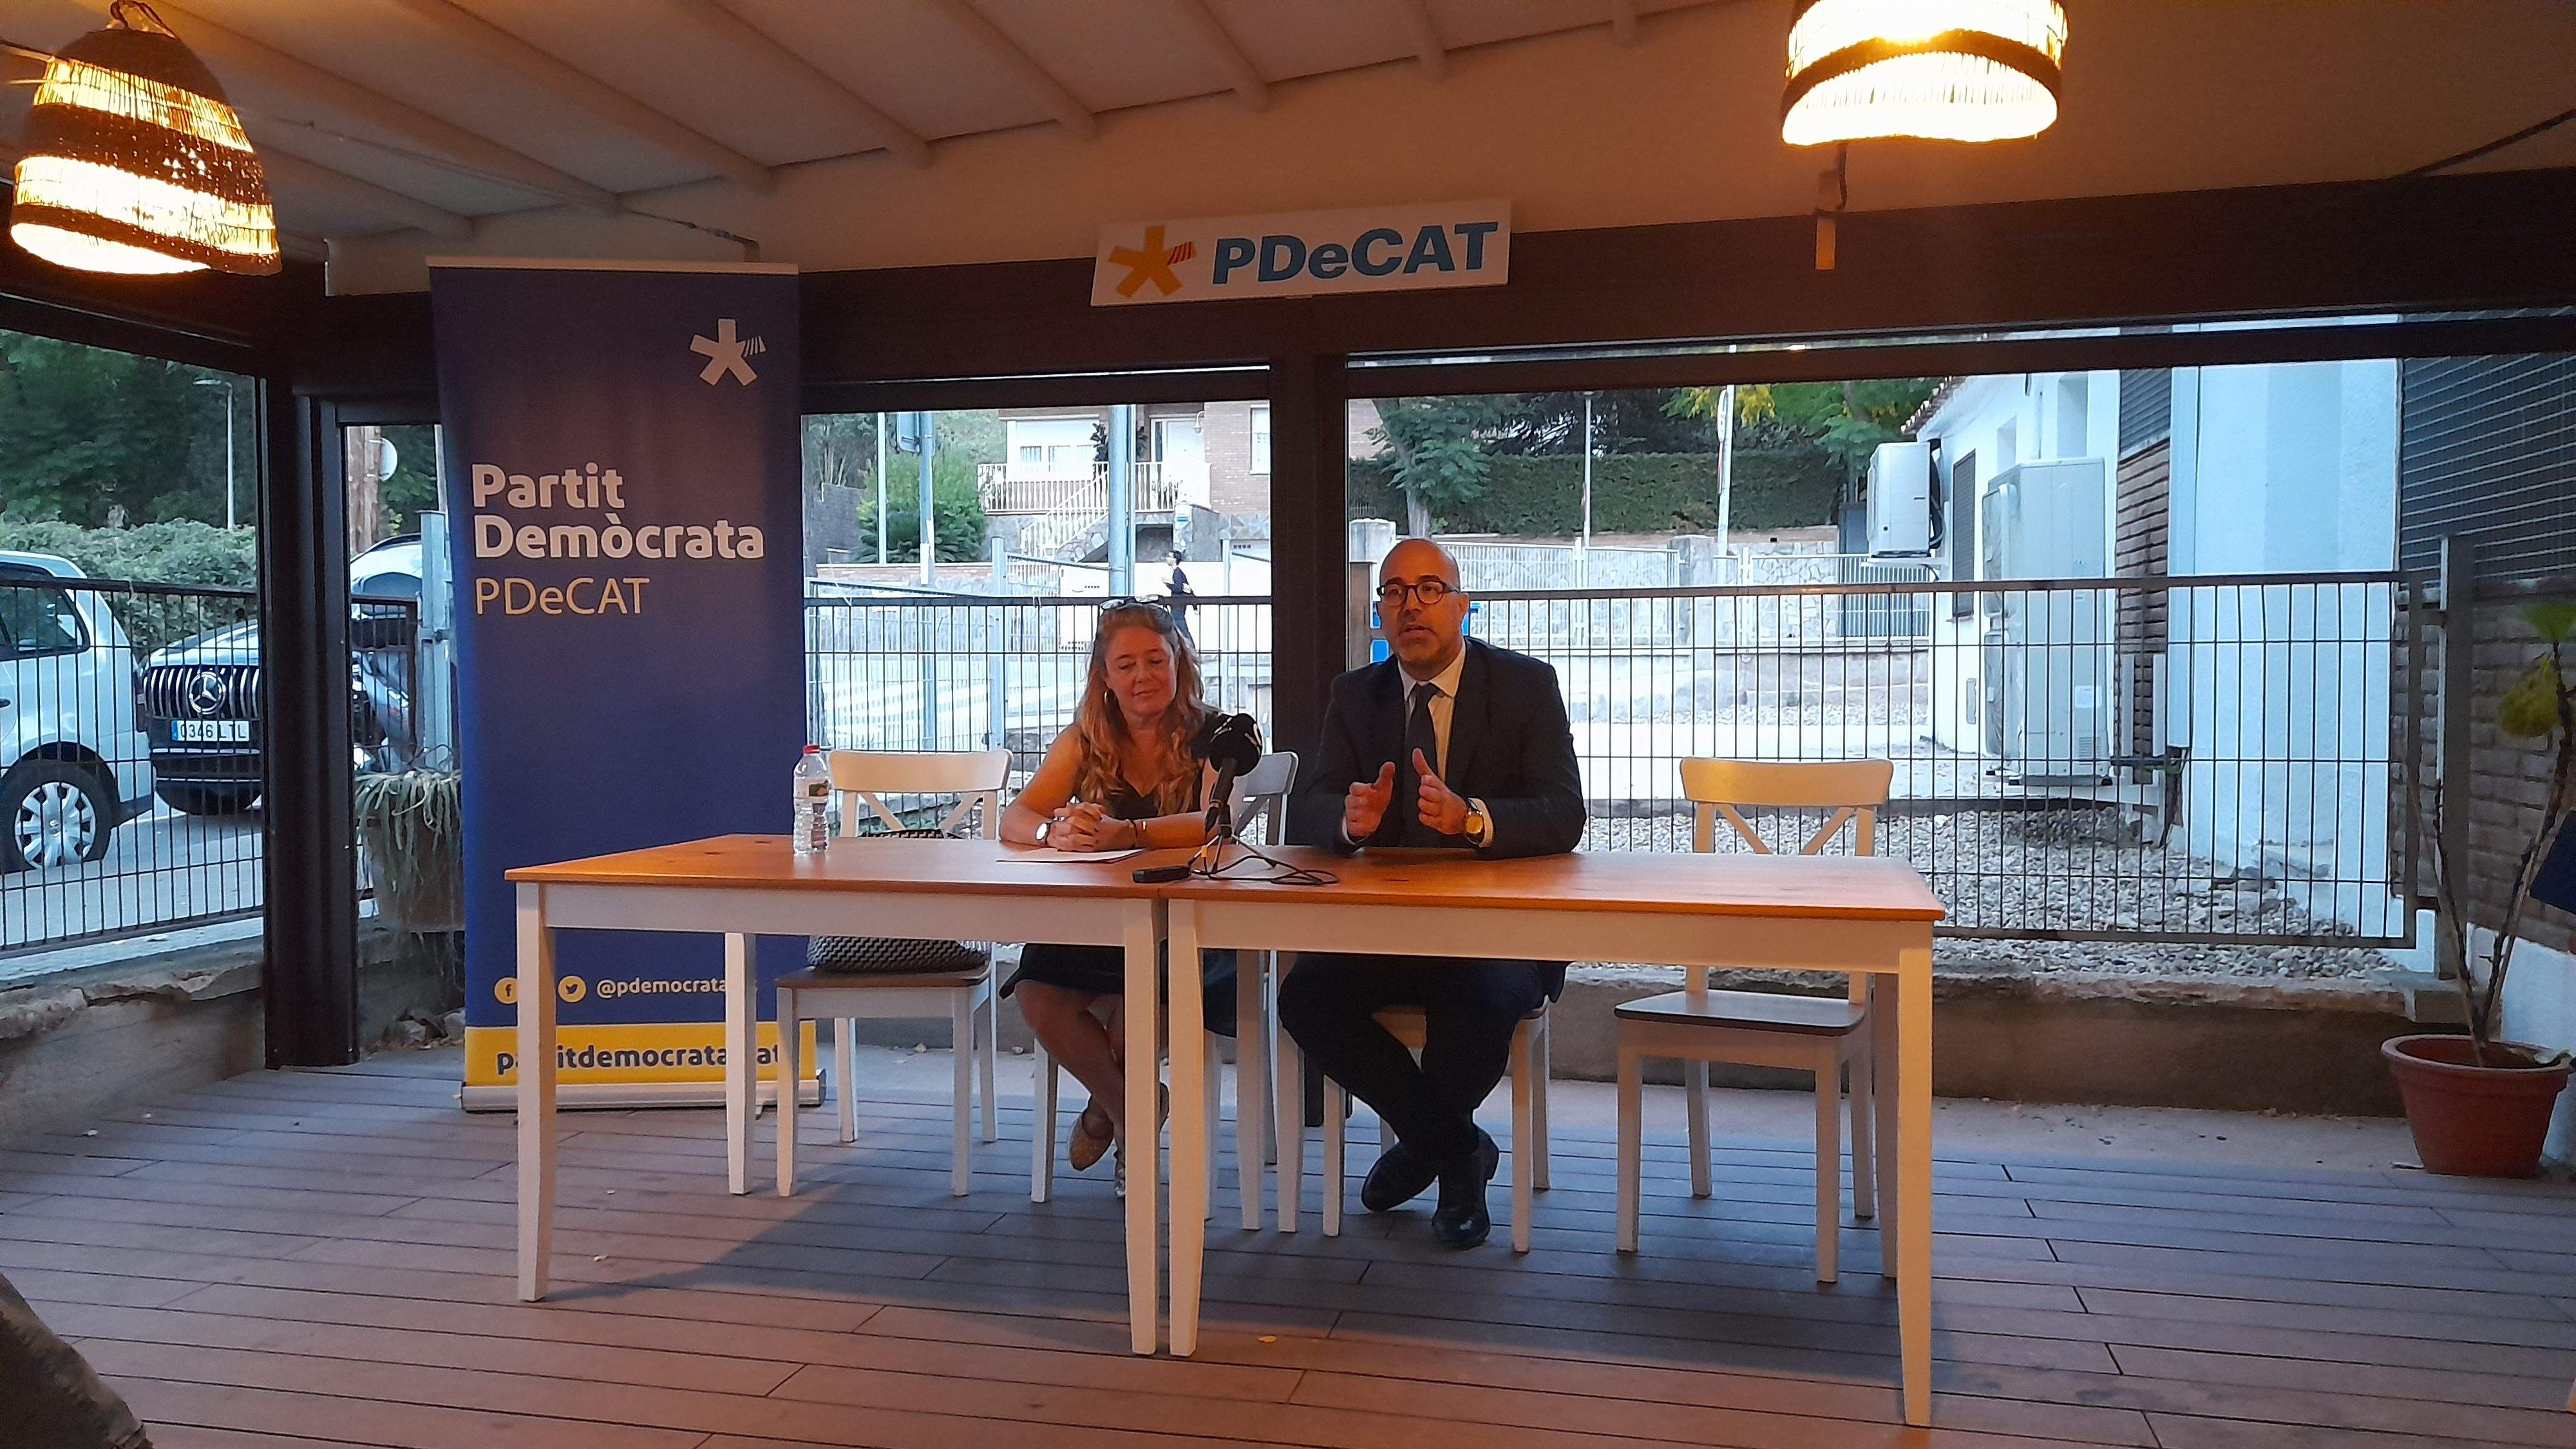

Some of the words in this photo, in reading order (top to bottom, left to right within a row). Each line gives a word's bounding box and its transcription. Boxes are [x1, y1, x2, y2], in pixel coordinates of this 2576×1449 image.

[1213, 222, 1499, 285] PDeCAT
[471, 462, 625, 509] Partit
[474, 513, 764, 559] Demòcrata
[475, 578, 650, 615] PDeCAT
[596, 976, 758, 999] @pdemocrata
